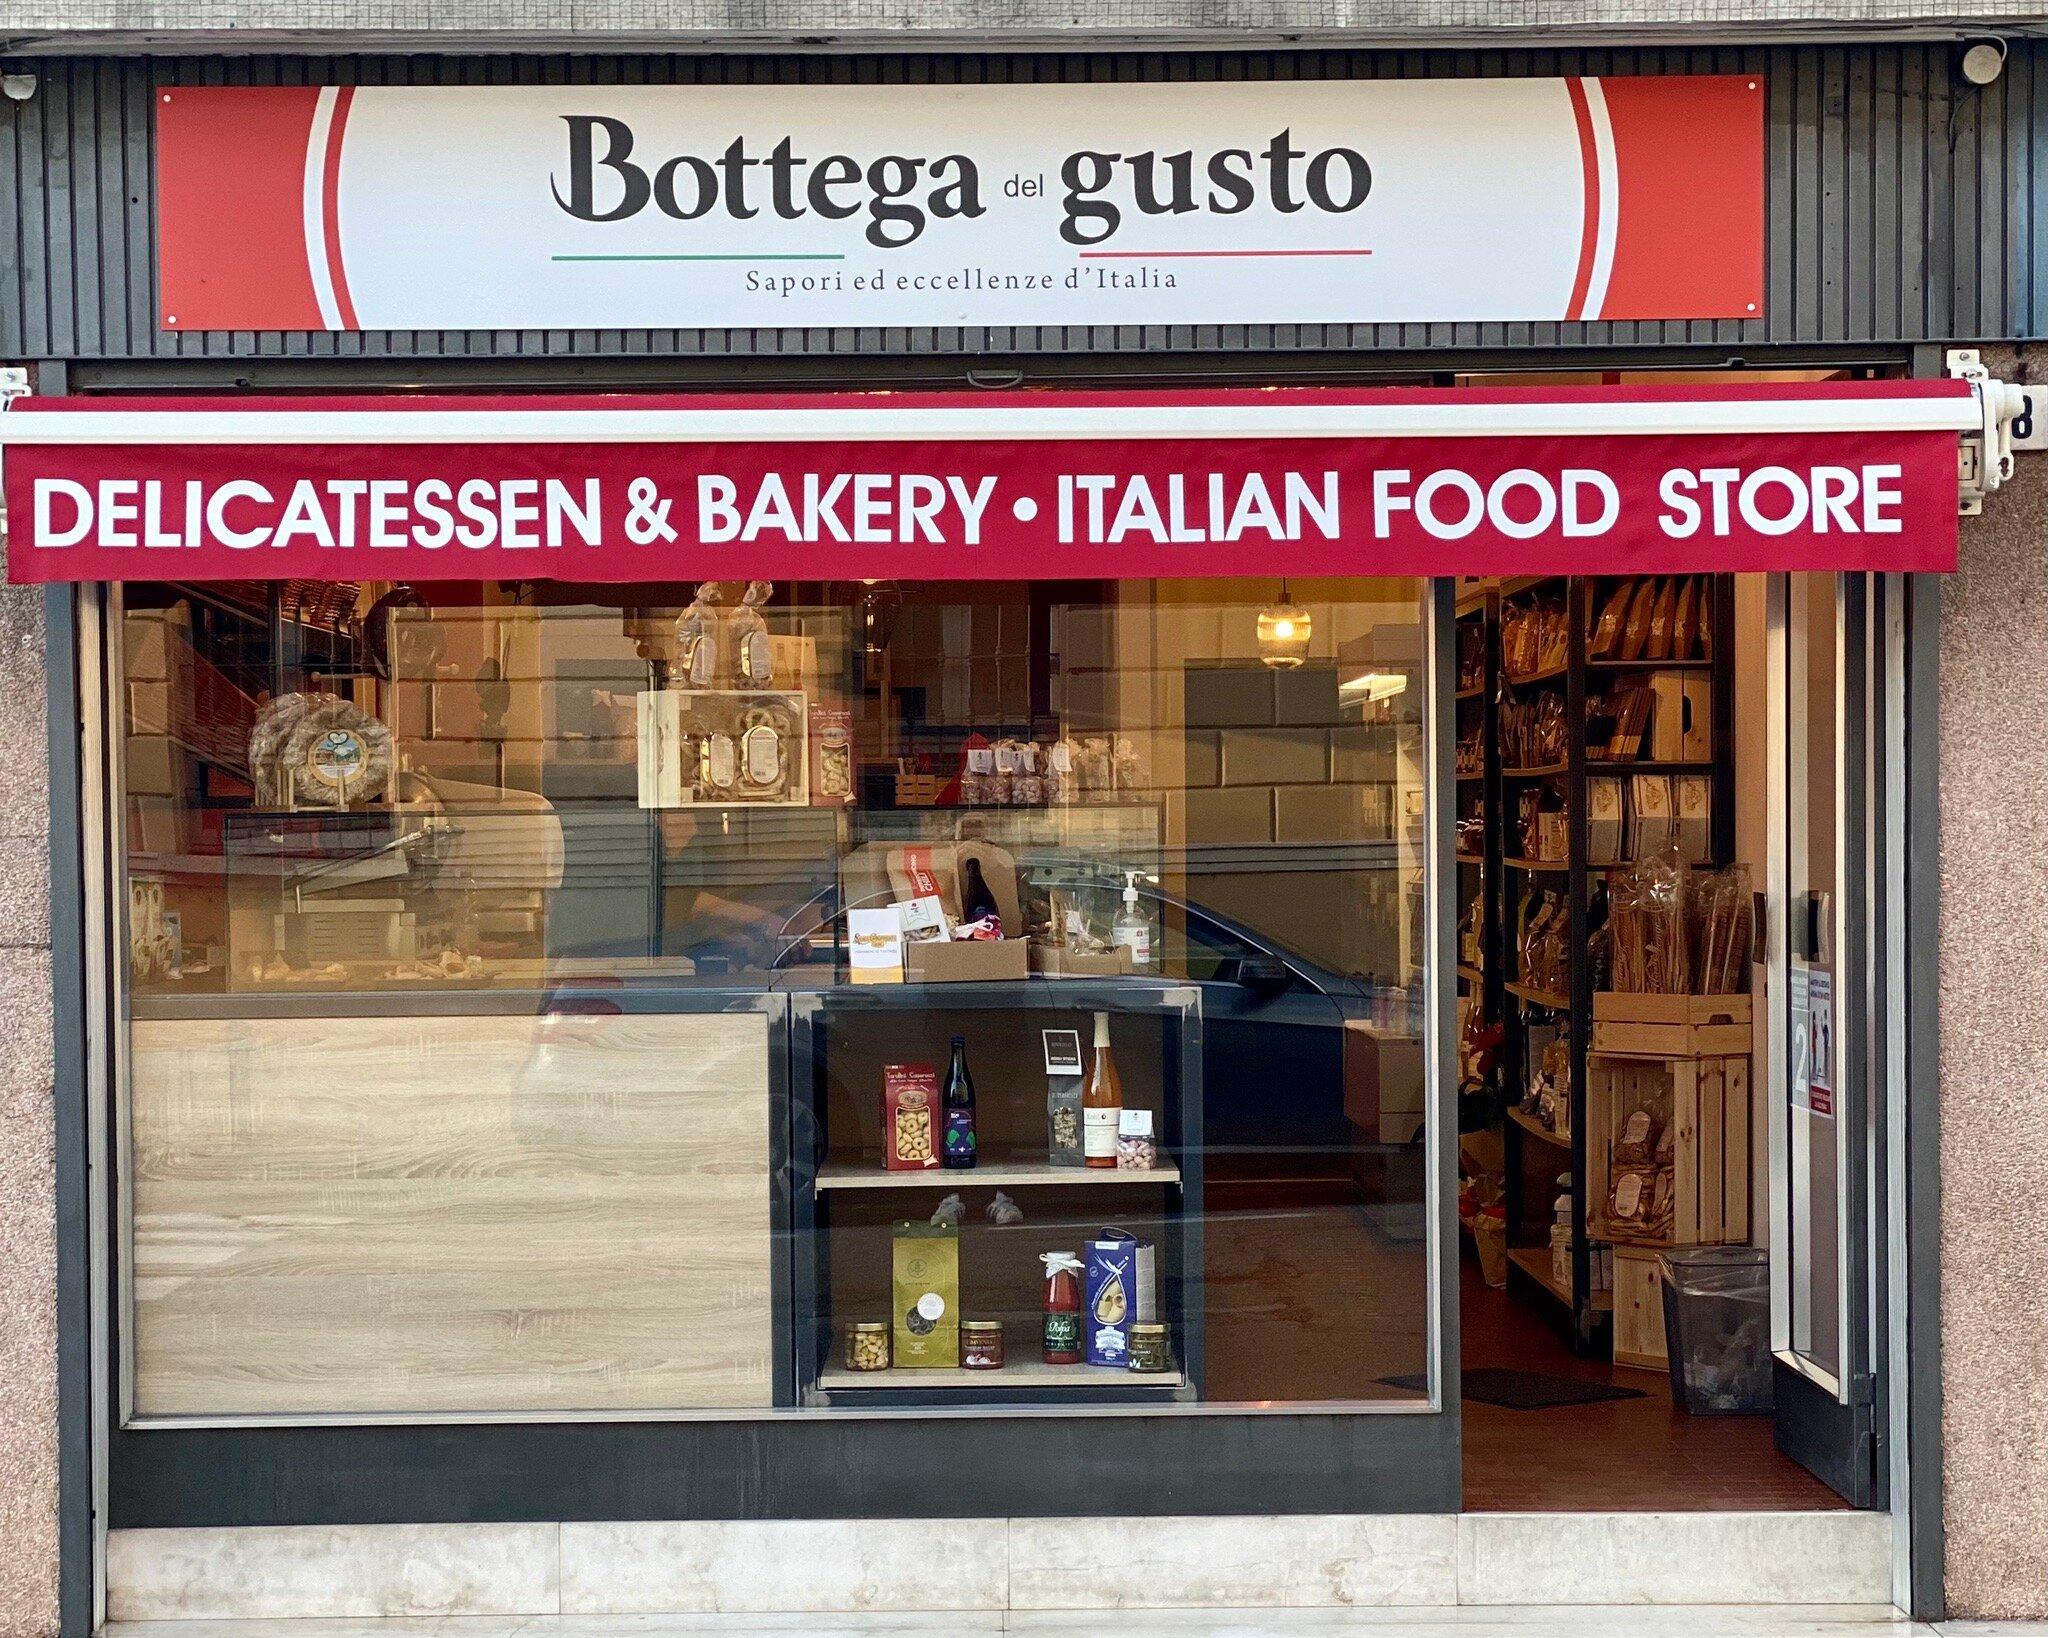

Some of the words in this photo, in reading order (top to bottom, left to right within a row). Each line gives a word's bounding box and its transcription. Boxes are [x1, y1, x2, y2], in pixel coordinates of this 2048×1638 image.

[550, 115, 987, 249] Bottega
[1004, 173, 1043, 198] del
[1059, 127, 1372, 246] gusto
[746, 270, 843, 298] Sapori
[853, 270, 885, 290] ed
[896, 268, 1053, 290] eccellenze
[33, 477, 602, 549] DELICATESSEN
[624, 476, 679, 545] &
[697, 472, 998, 545] BAKERY
[1057, 470, 1340, 544] ITALIAN
[1373, 468, 1620, 540] FOOD
[1658, 464, 1902, 539] STORE
